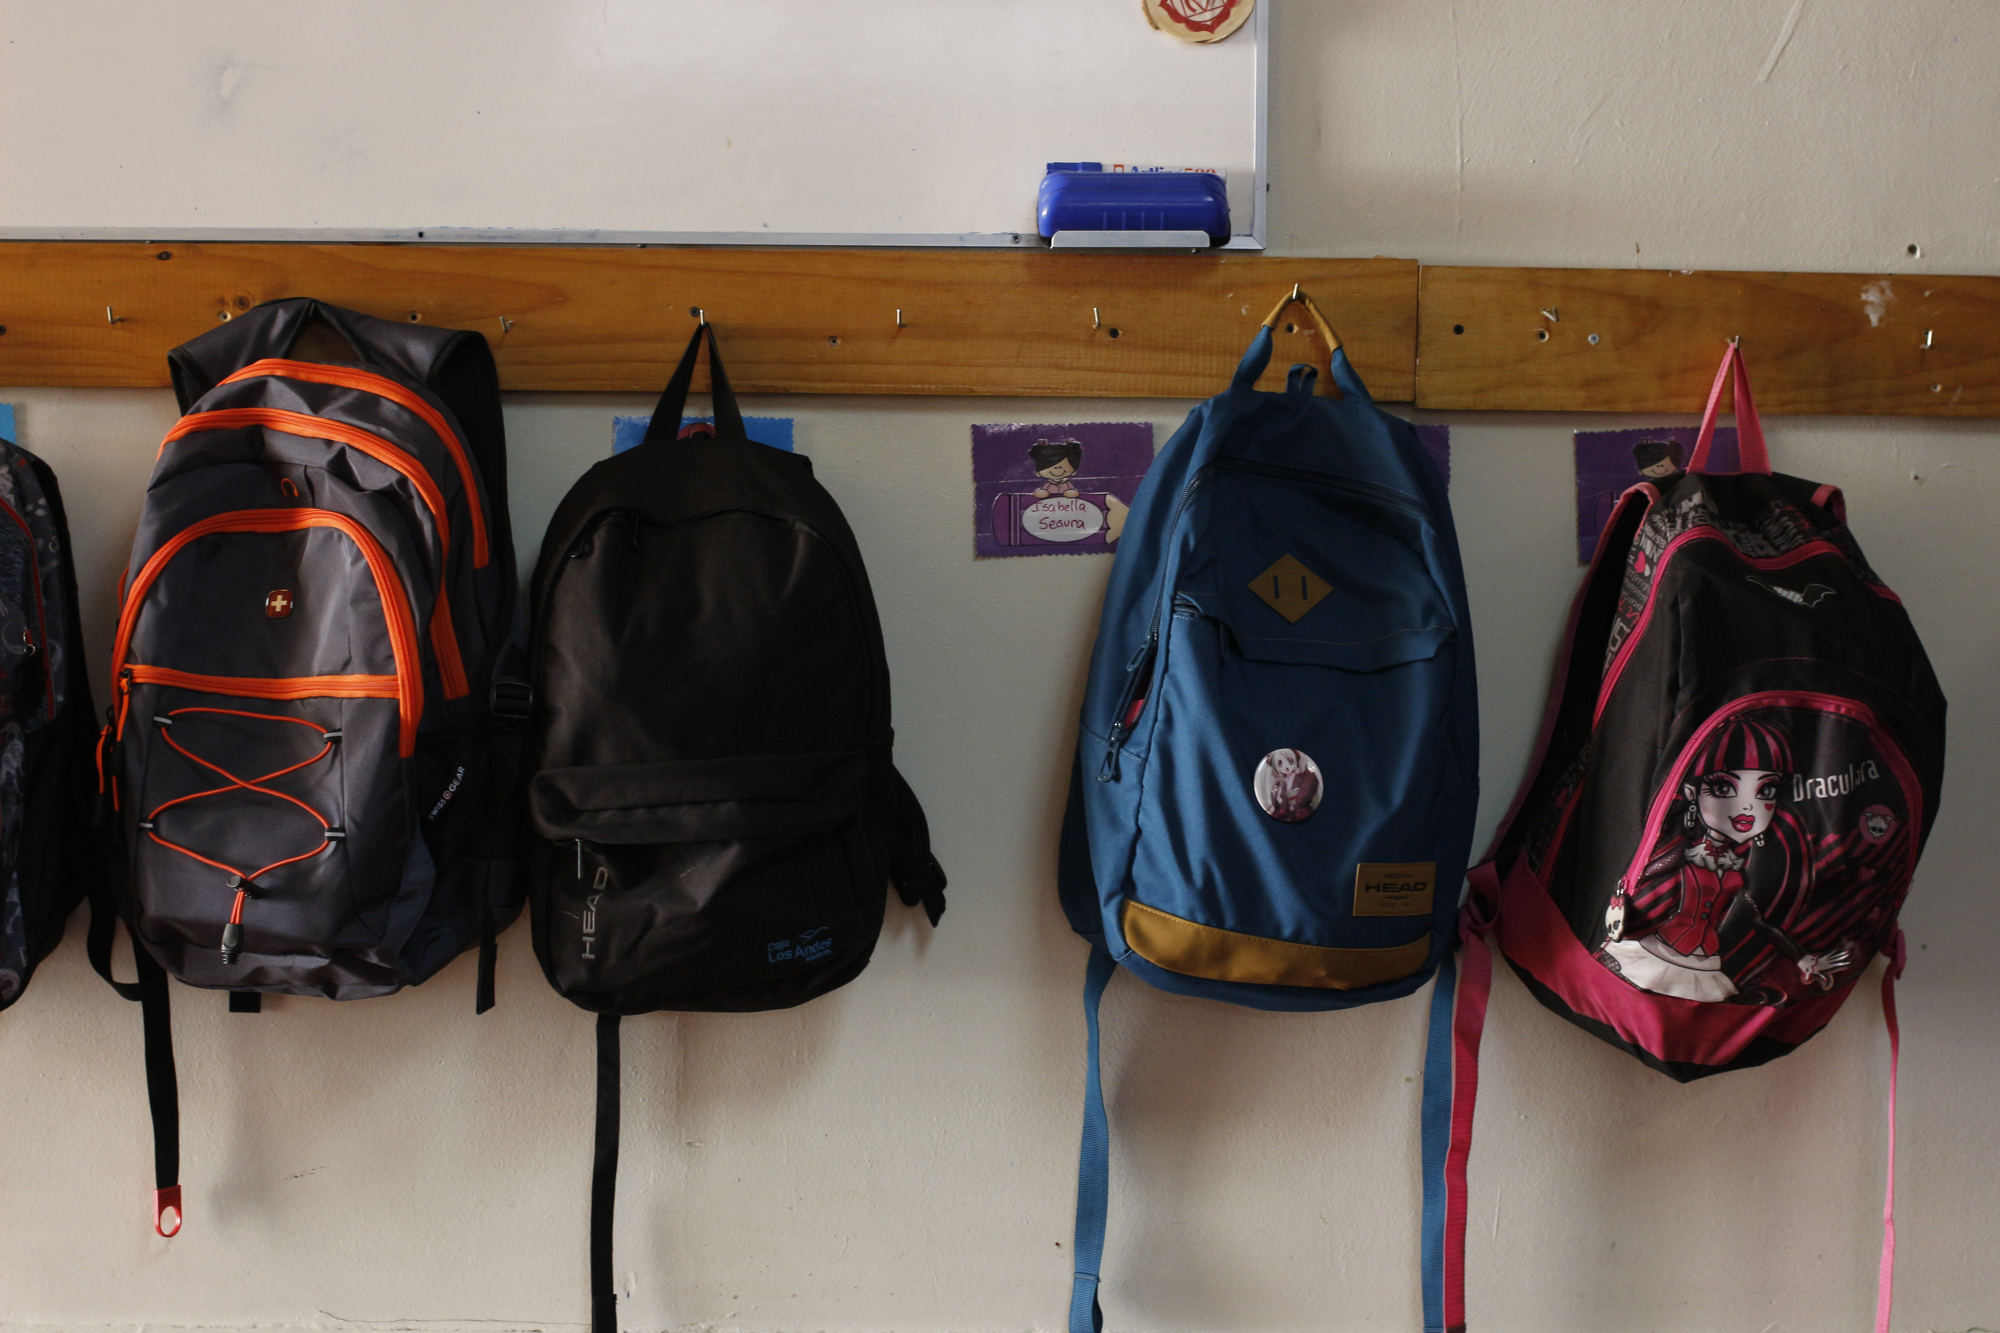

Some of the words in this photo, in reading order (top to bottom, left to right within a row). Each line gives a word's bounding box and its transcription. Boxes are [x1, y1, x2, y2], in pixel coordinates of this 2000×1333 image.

[1031, 499, 1086, 513] Isabella
[448, 766, 465, 792] GEAR
[1365, 882, 1427, 893] HEAD
[582, 867, 608, 960] HEAD
